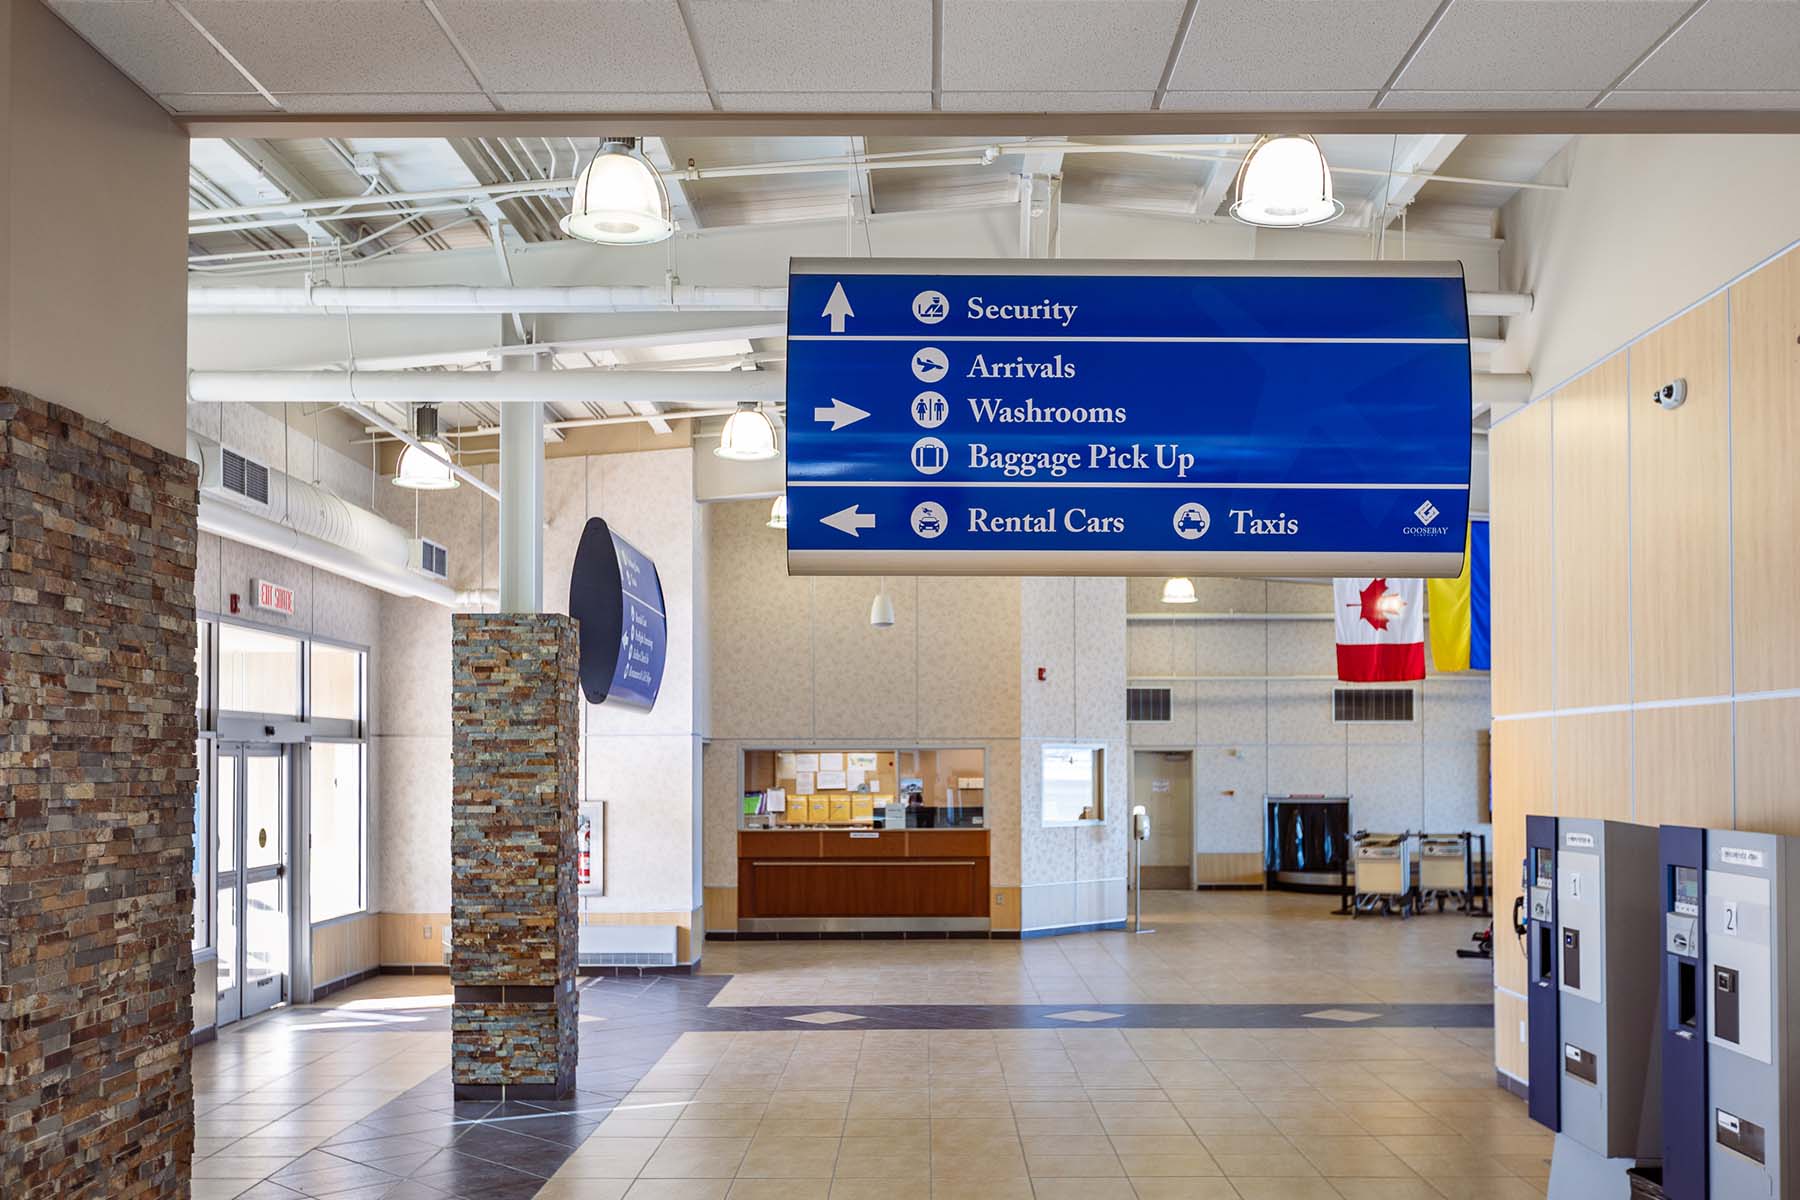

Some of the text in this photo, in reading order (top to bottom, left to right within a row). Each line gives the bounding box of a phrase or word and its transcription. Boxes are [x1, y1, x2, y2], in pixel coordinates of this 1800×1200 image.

[967, 296, 1078, 327] Security
[966, 354, 1076, 379] Arrivals
[967, 398, 1127, 424] Washrooms
[968, 443, 1195, 478] Baggage Pick Up
[967, 507, 1125, 533] Rental Cars
[1228, 509, 1299, 535] Taxis
[1726, 908, 1735, 931] 2
